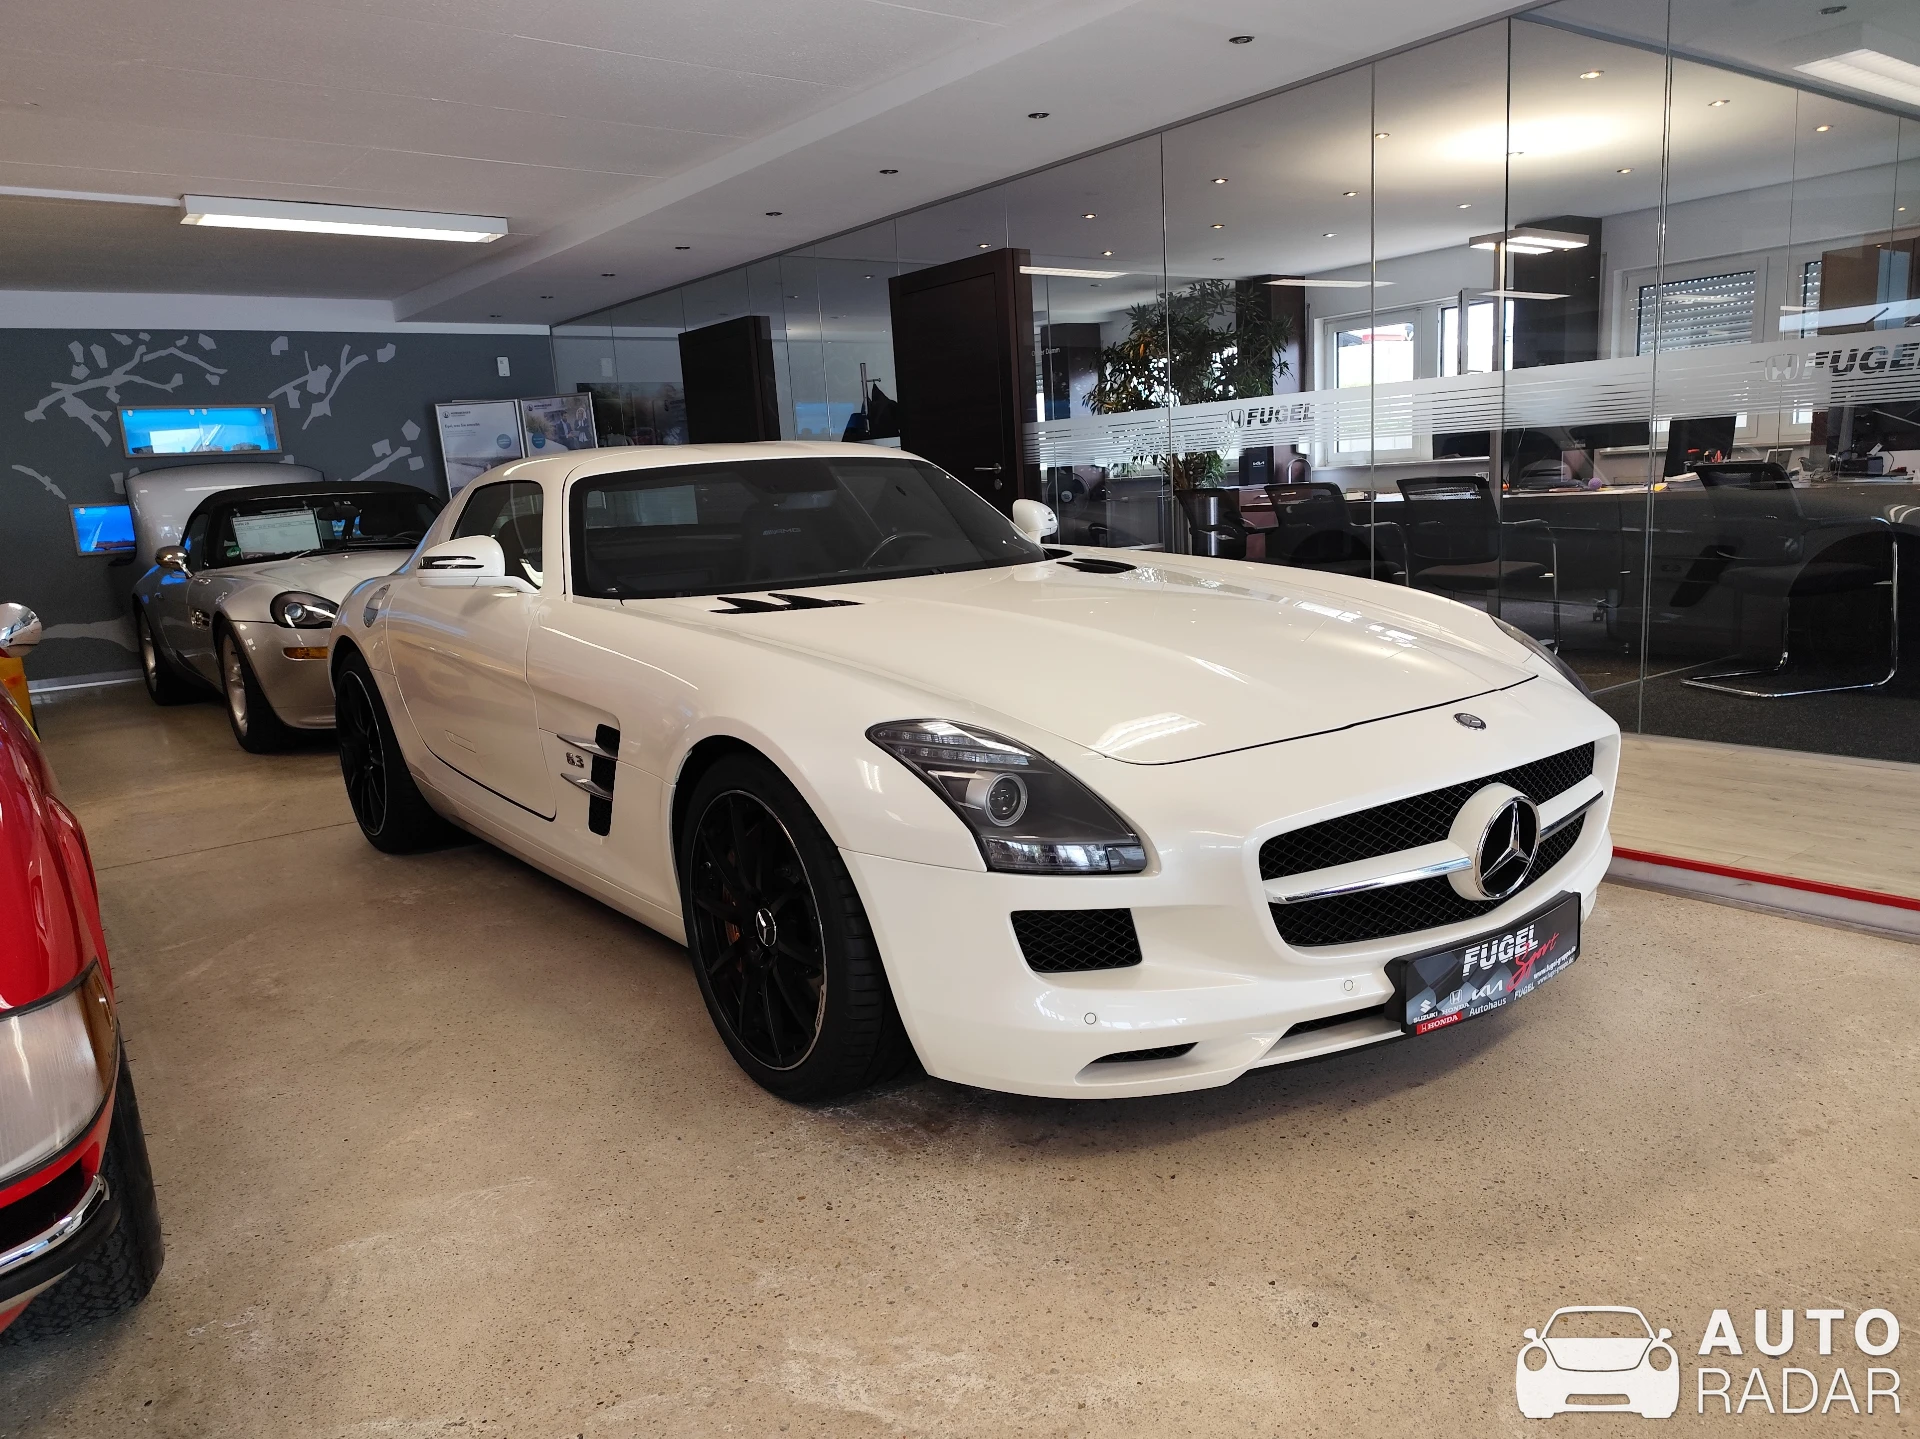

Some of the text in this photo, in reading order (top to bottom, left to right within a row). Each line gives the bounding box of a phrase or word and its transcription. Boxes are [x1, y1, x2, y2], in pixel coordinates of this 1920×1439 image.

[1802, 342, 1920, 379] FUGE
[1246, 403, 1315, 427] FUGEL
[1463, 924, 1538, 977] FUGEL
[1506, 932, 1559, 992] Sport
[1441, 1002, 1470, 1015] HONDA
[1469, 997, 1507, 1017] Autohaus
[1514, 981, 1535, 1000] FUGEL
[1413, 1011, 1438, 1023] SUZUKI
[1427, 1014, 1458, 1030] HONDA
